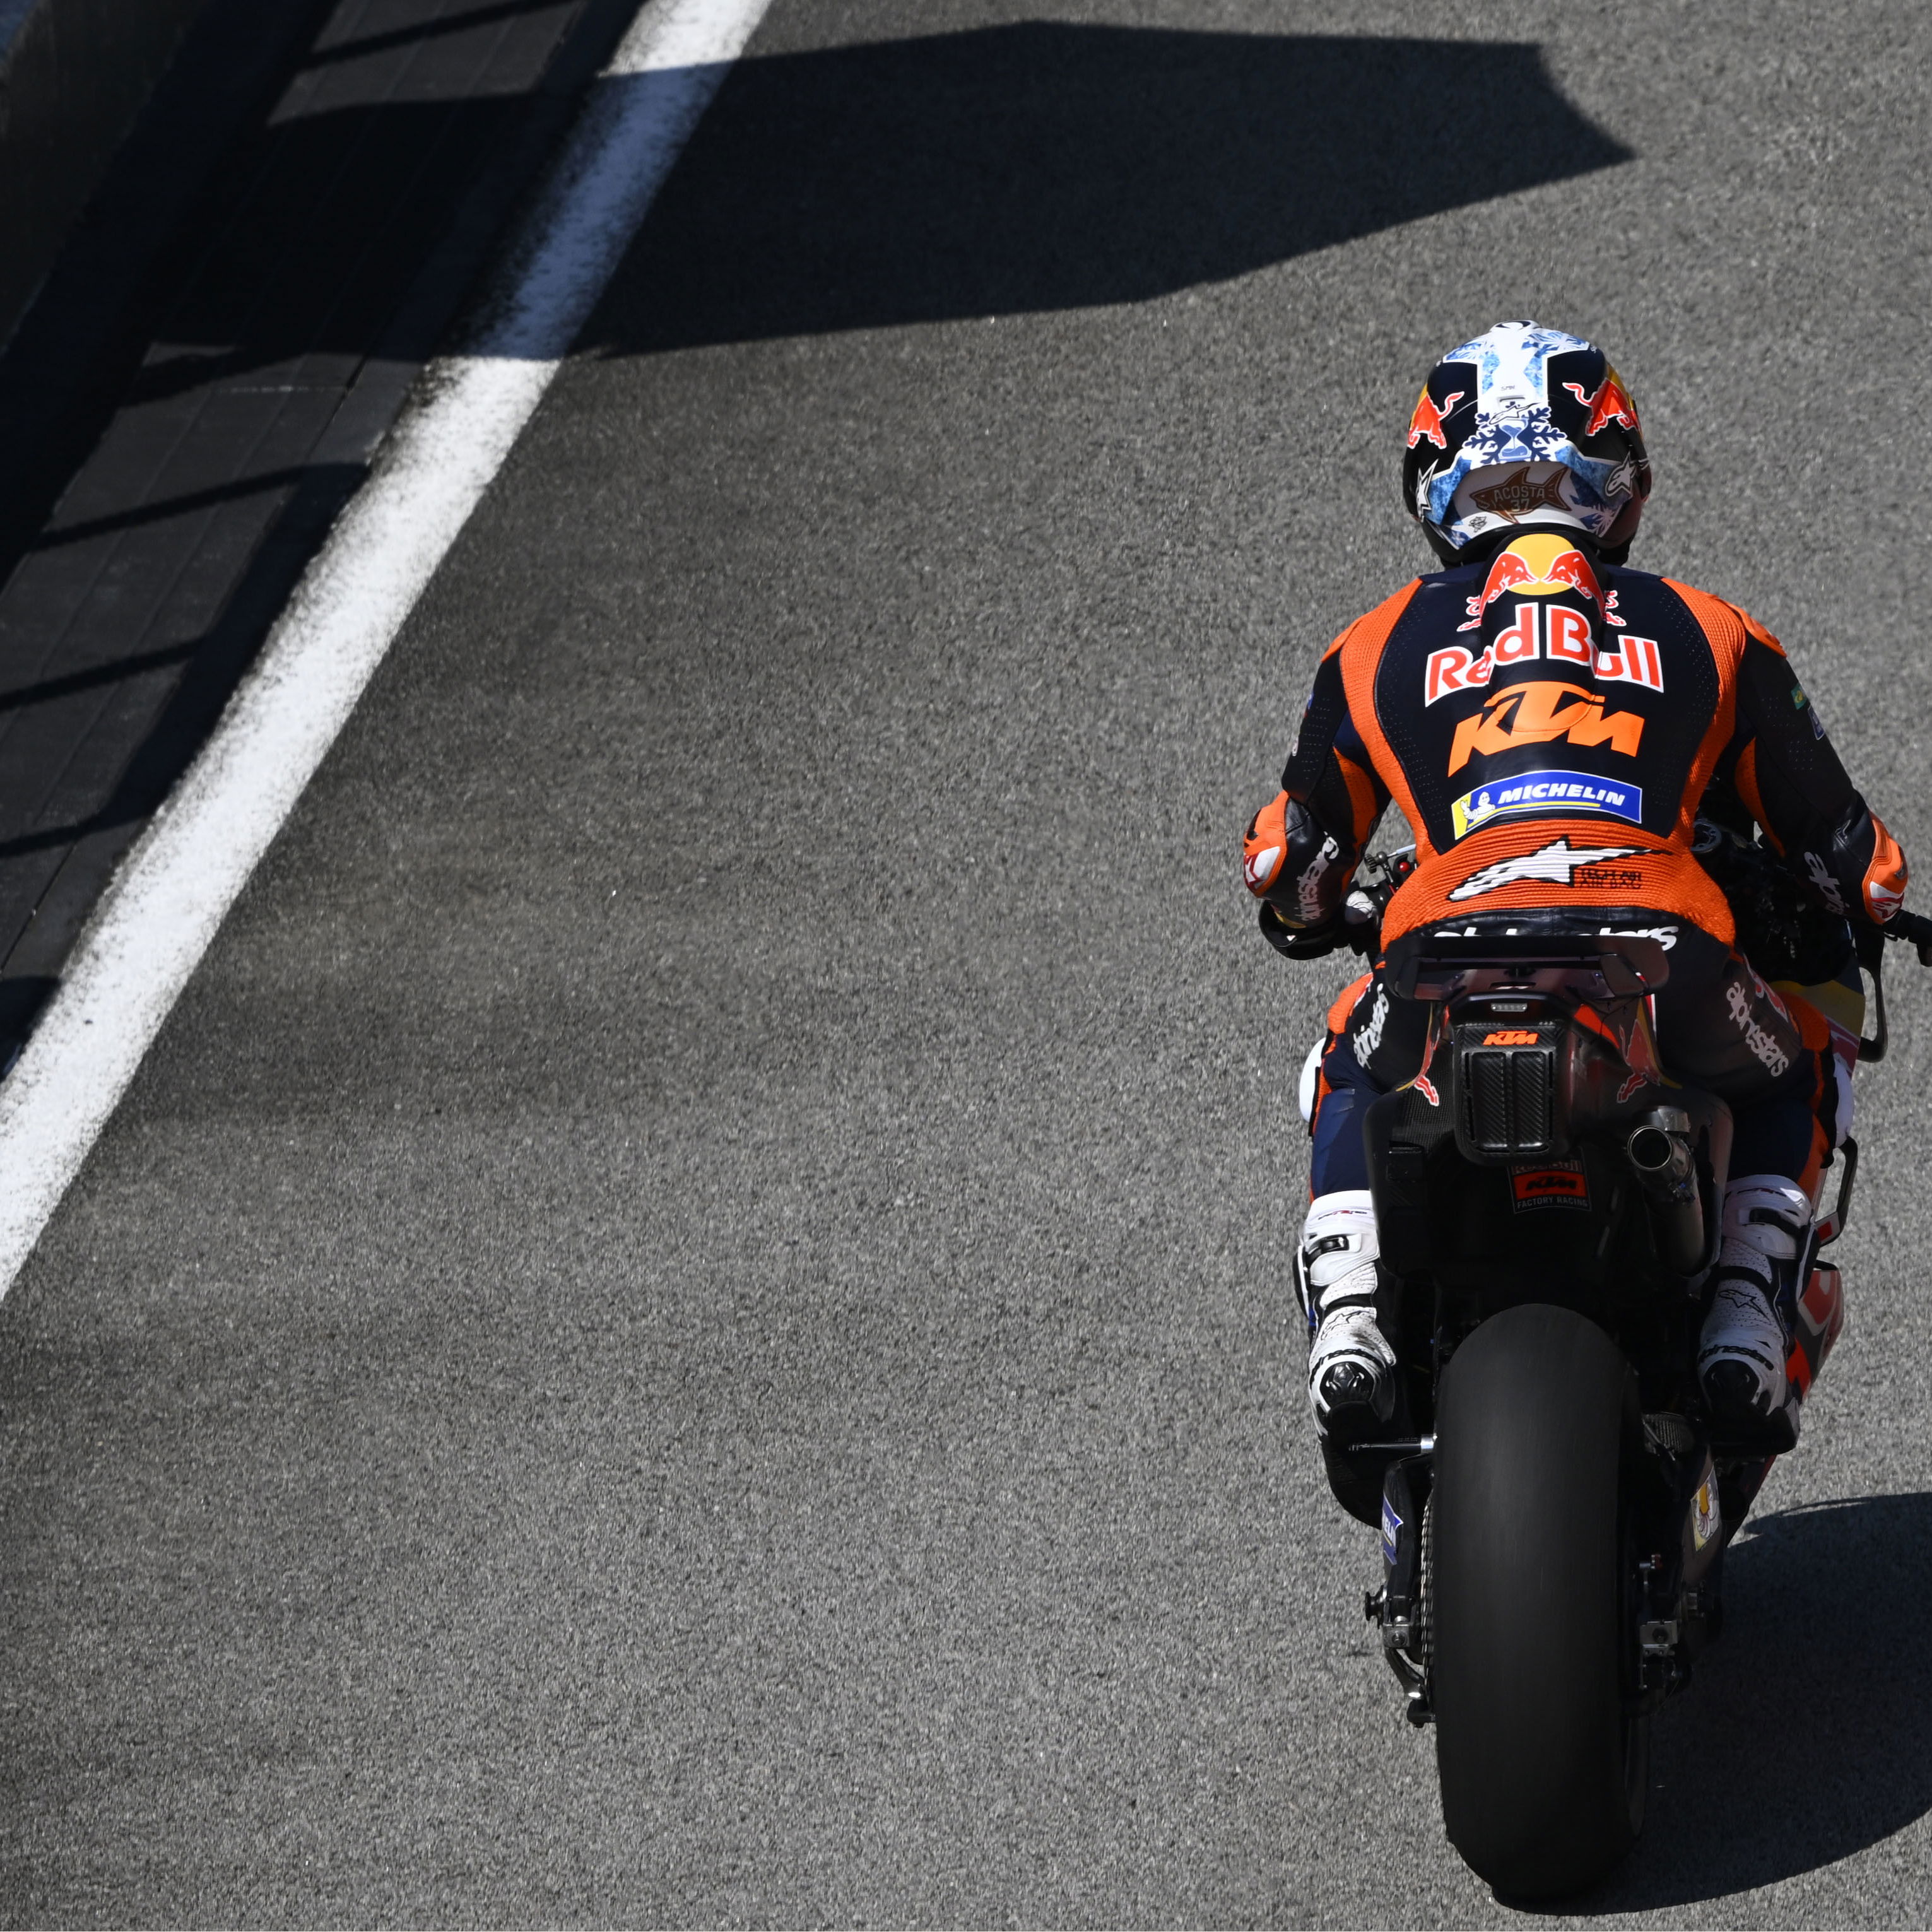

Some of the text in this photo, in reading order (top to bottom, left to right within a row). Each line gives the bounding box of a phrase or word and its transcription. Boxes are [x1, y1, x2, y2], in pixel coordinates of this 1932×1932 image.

[1493, 485, 1545, 503] ACOSTA
[1511, 499, 1530, 512] 37
[1425, 602, 1664, 707] Red Bull
[1447, 681, 1645, 778] KTM
[1497, 783, 1626, 806] MICHELIN
[1483, 1030, 1538, 1046] KTM
[1526, 1176, 1577, 1191] KTM
[1517, 1196, 1589, 1209] FACTORY RACING
